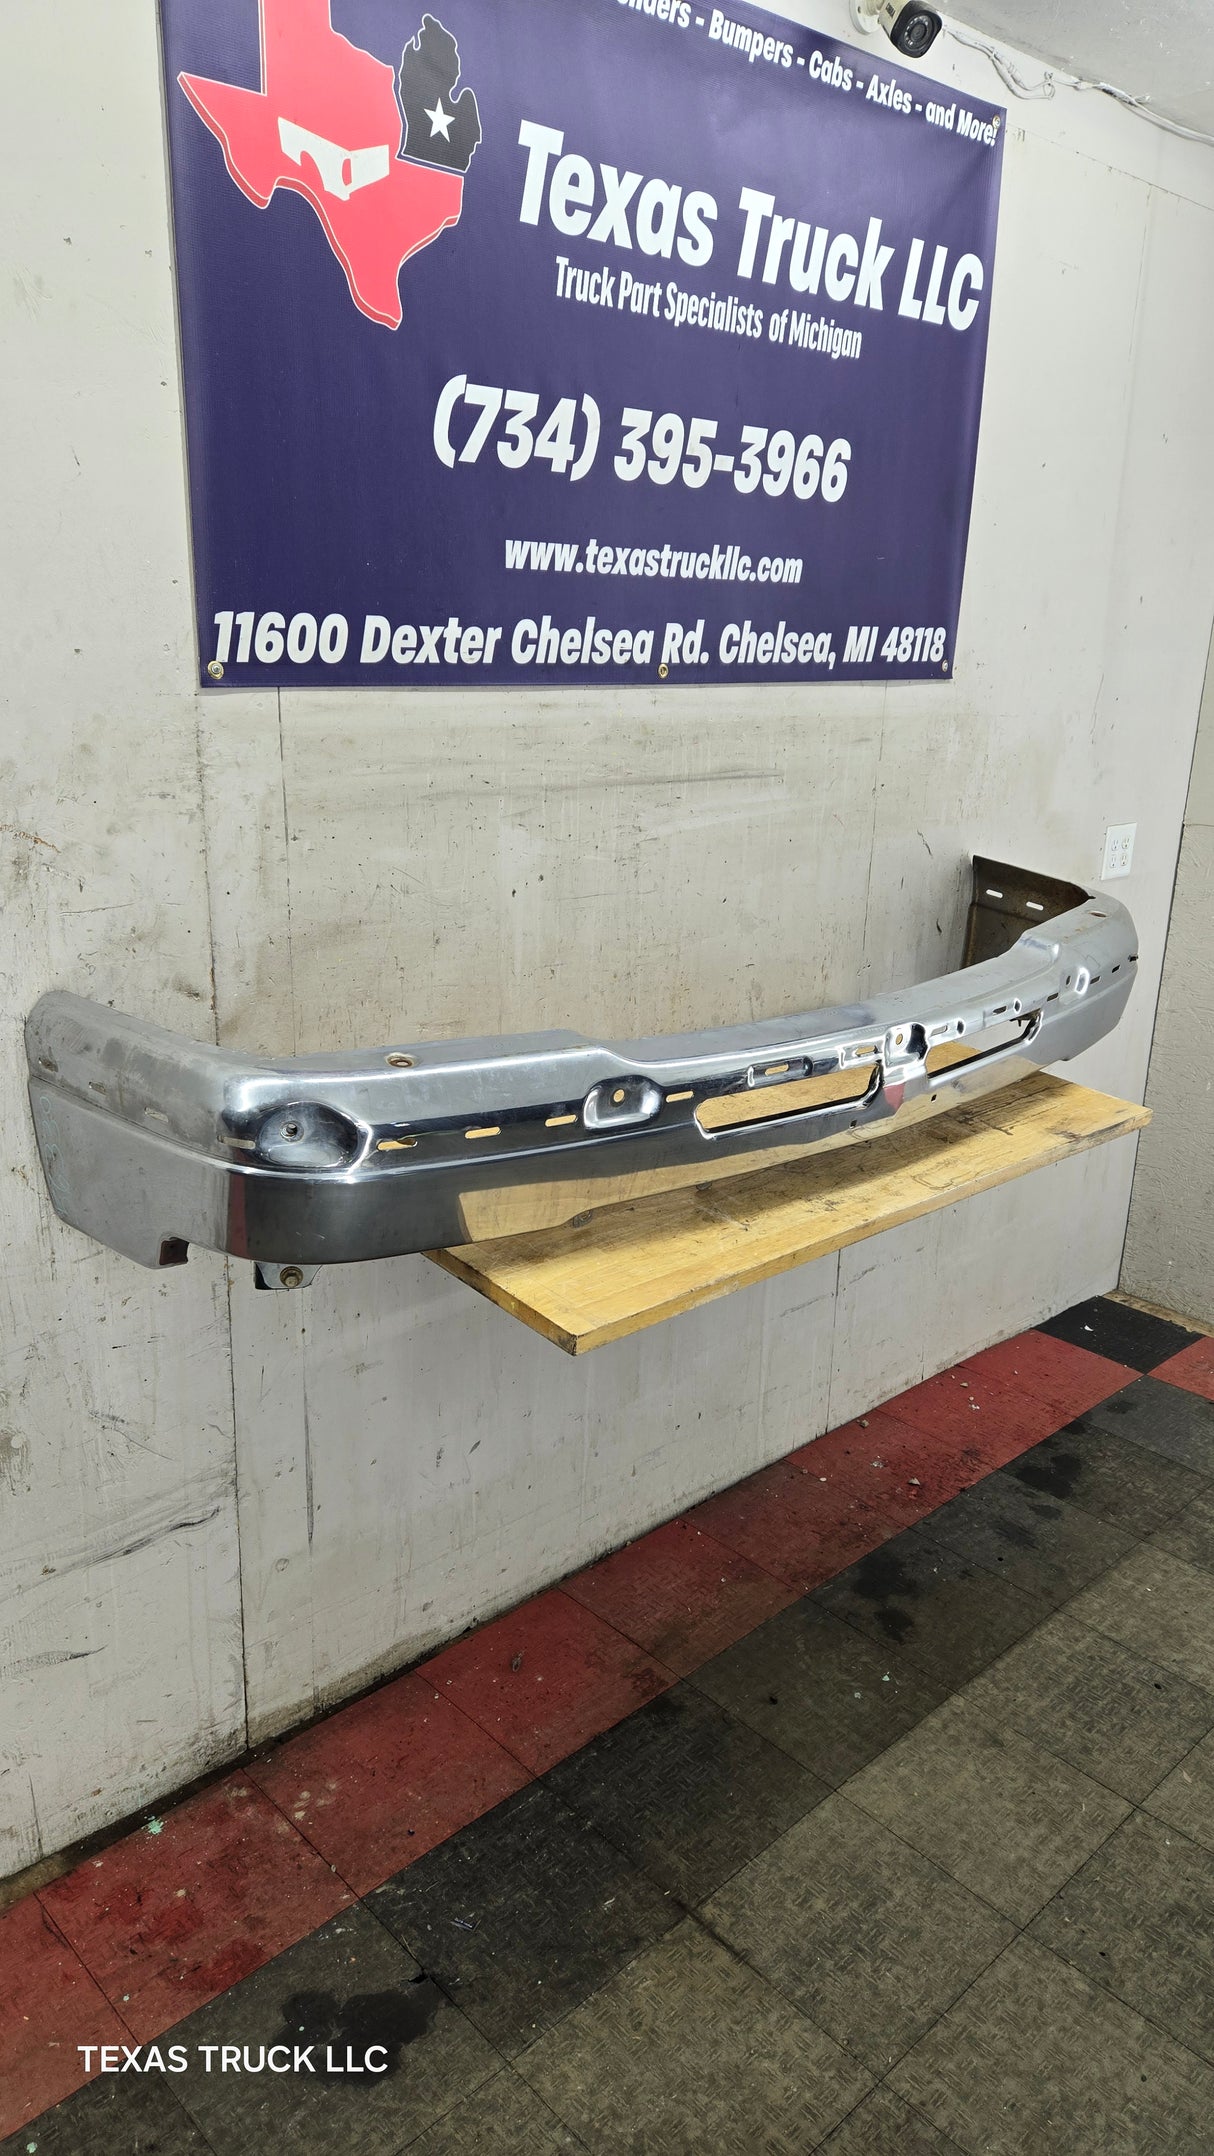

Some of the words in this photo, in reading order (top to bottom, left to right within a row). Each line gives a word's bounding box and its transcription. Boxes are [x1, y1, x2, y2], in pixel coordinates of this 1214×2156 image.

[708, 8, 794, 68] Bumpers
[809, 50, 853, 91] Cabs
[865, 74, 913, 114] Axles
[925, 101, 957, 131] and
[956, 108, 998, 147] More!
[518, 119, 718, 267] Texas
[737, 186, 895, 311] Truck
[897, 237, 984, 332] LLC
[555, 255, 616, 308] Truck
[617, 270, 663, 316] Part
[663, 281, 764, 339] Specialists
[768, 308, 789, 343] of
[789, 315, 863, 362] Michigan
[433, 374, 600, 481] (734)
[613, 407, 852, 503] 395-3966
[505, 538, 803, 585] www.texastruckllc.com
[212, 611, 349, 664] 11600
[359, 615, 503, 665] Dexter
[511, 615, 655, 664] Chelsea
[660, 622, 709, 665] Rd.
[719, 619, 836, 670] Chelsea,
[842, 626, 879, 663] MI
[880, 626, 946, 665] 48118
